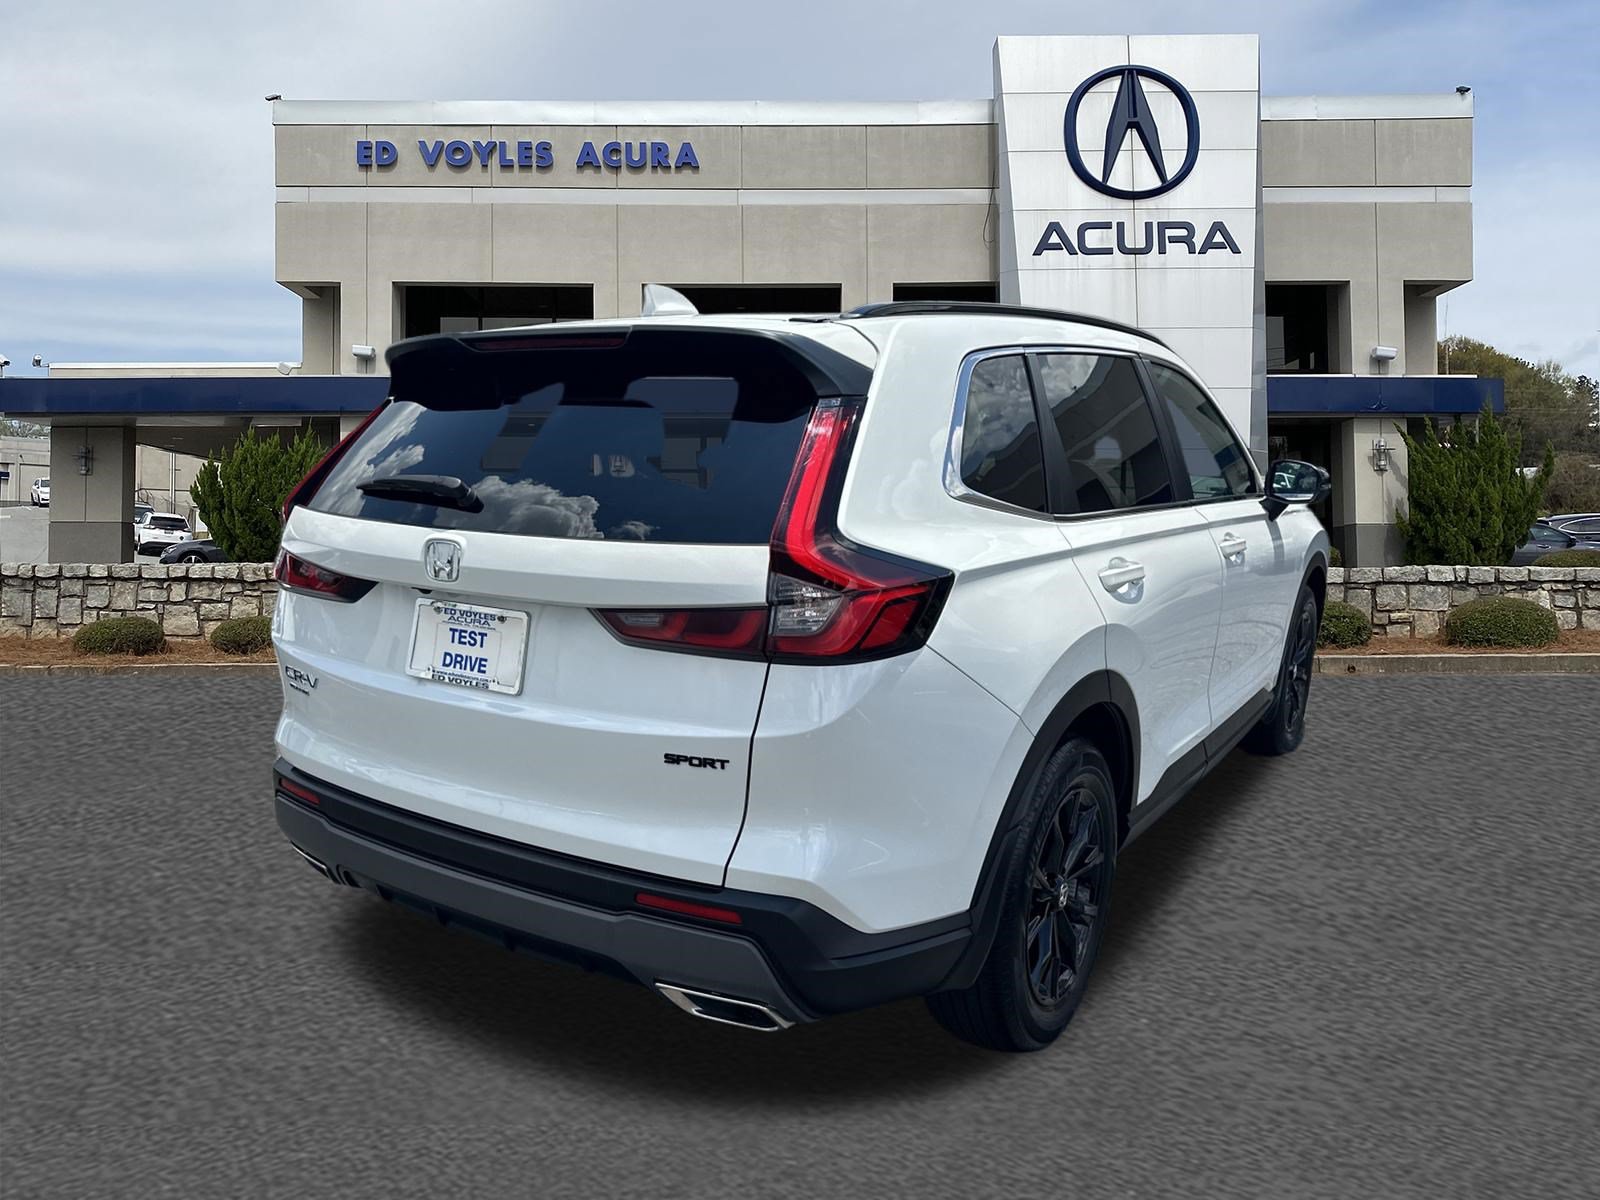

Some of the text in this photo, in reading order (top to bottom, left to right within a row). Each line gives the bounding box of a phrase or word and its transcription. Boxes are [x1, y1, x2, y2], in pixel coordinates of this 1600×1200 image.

[356, 140, 700, 168] ED VOYLES ACURA
[1032, 221, 1242, 256] ACURA
[443, 607, 497, 621] ED VOYLES
[448, 615, 491, 627] ACURA
[449, 627, 488, 648] TEST
[442, 651, 488, 674] DRIVE
[285, 665, 318, 688] CR-V
[431, 673, 446, 682] ED
[448, 677, 490, 690] VOYLES
[663, 752, 730, 770] SPORT
